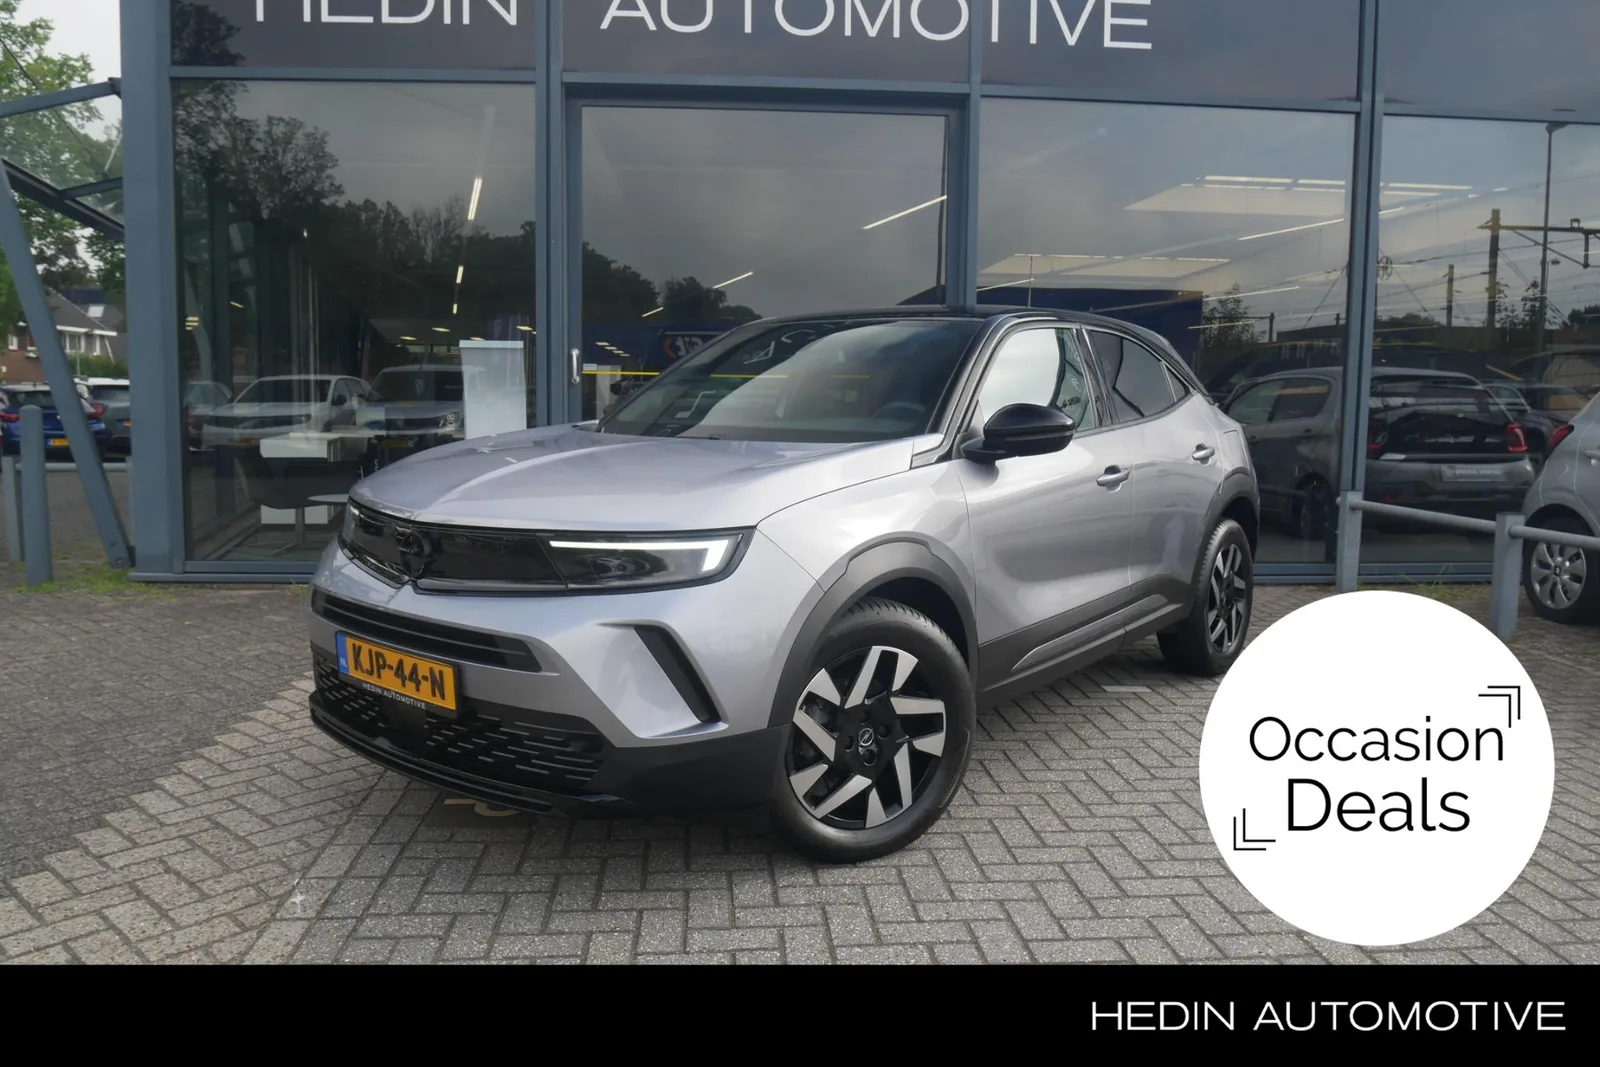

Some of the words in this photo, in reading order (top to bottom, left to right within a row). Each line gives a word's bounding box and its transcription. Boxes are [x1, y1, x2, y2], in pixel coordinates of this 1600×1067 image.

[351, 642, 446, 701] KJP-44-N
[362, 682, 382, 694] HEDIN
[383, 690, 427, 710] AUTOMOTIVE
